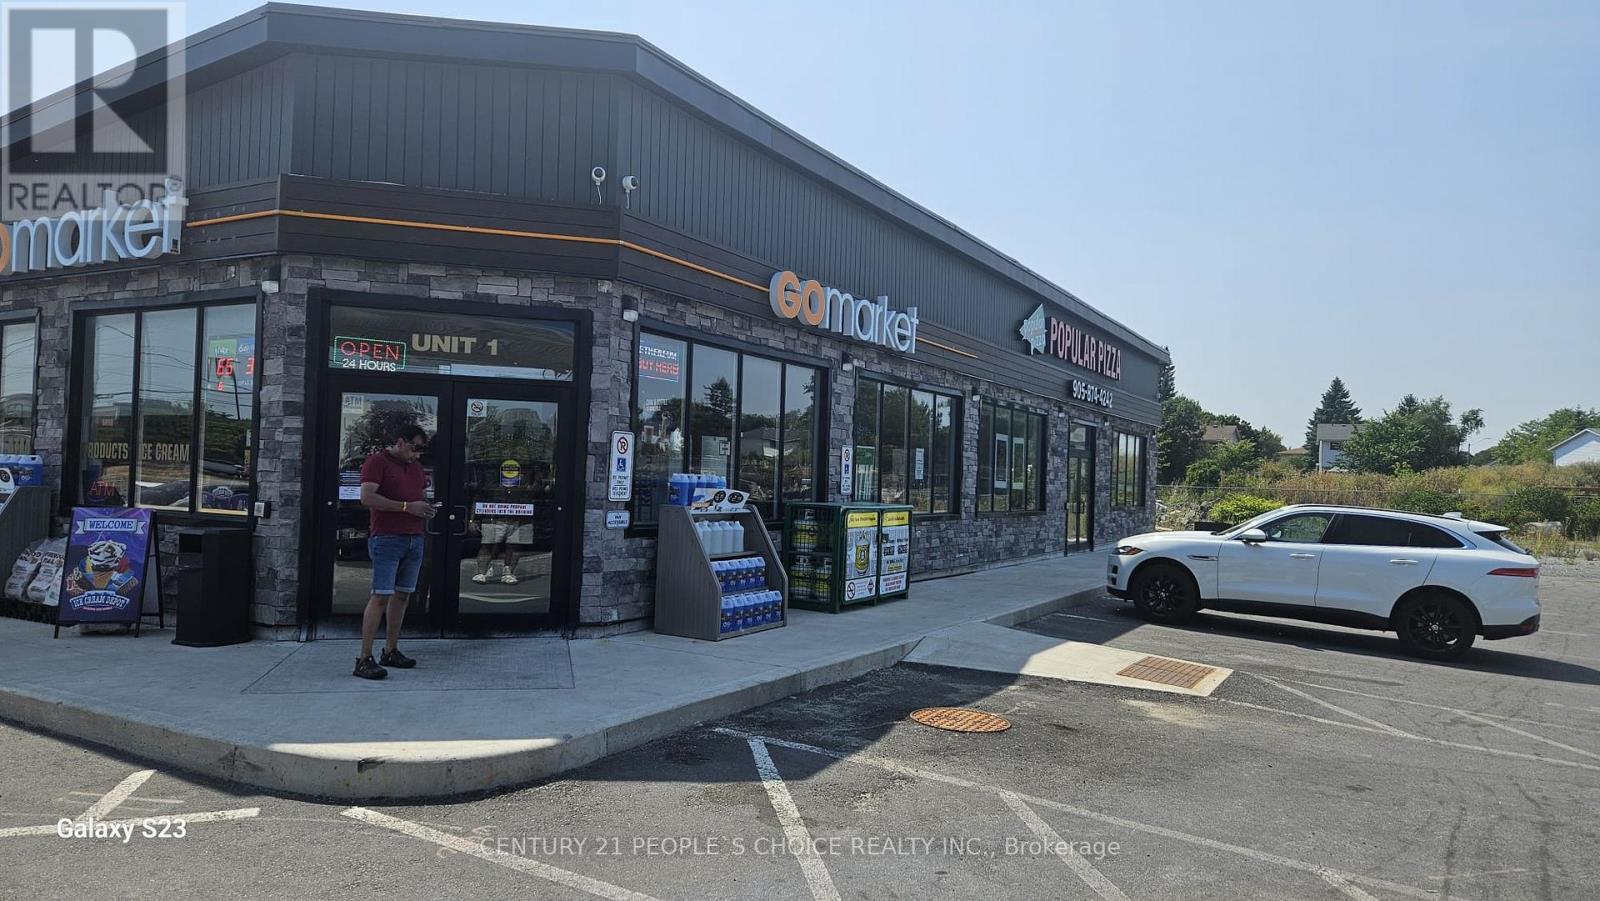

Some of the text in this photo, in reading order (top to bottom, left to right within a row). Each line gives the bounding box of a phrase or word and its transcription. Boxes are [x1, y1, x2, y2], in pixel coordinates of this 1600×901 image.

[340, 341, 400, 361] OPEN
[411, 333, 498, 355] UNIT 1
[1050, 317, 1096, 372] POPULAR
[1098, 340, 1121, 381] PIZZA
[342, 358, 396, 372] 24 HOURS
[155, 443, 190, 462] CREAM
[89, 520, 134, 530] WELCOME
[73, 600, 84, 608] ICE
[106, 597, 125, 607] DEPOT
